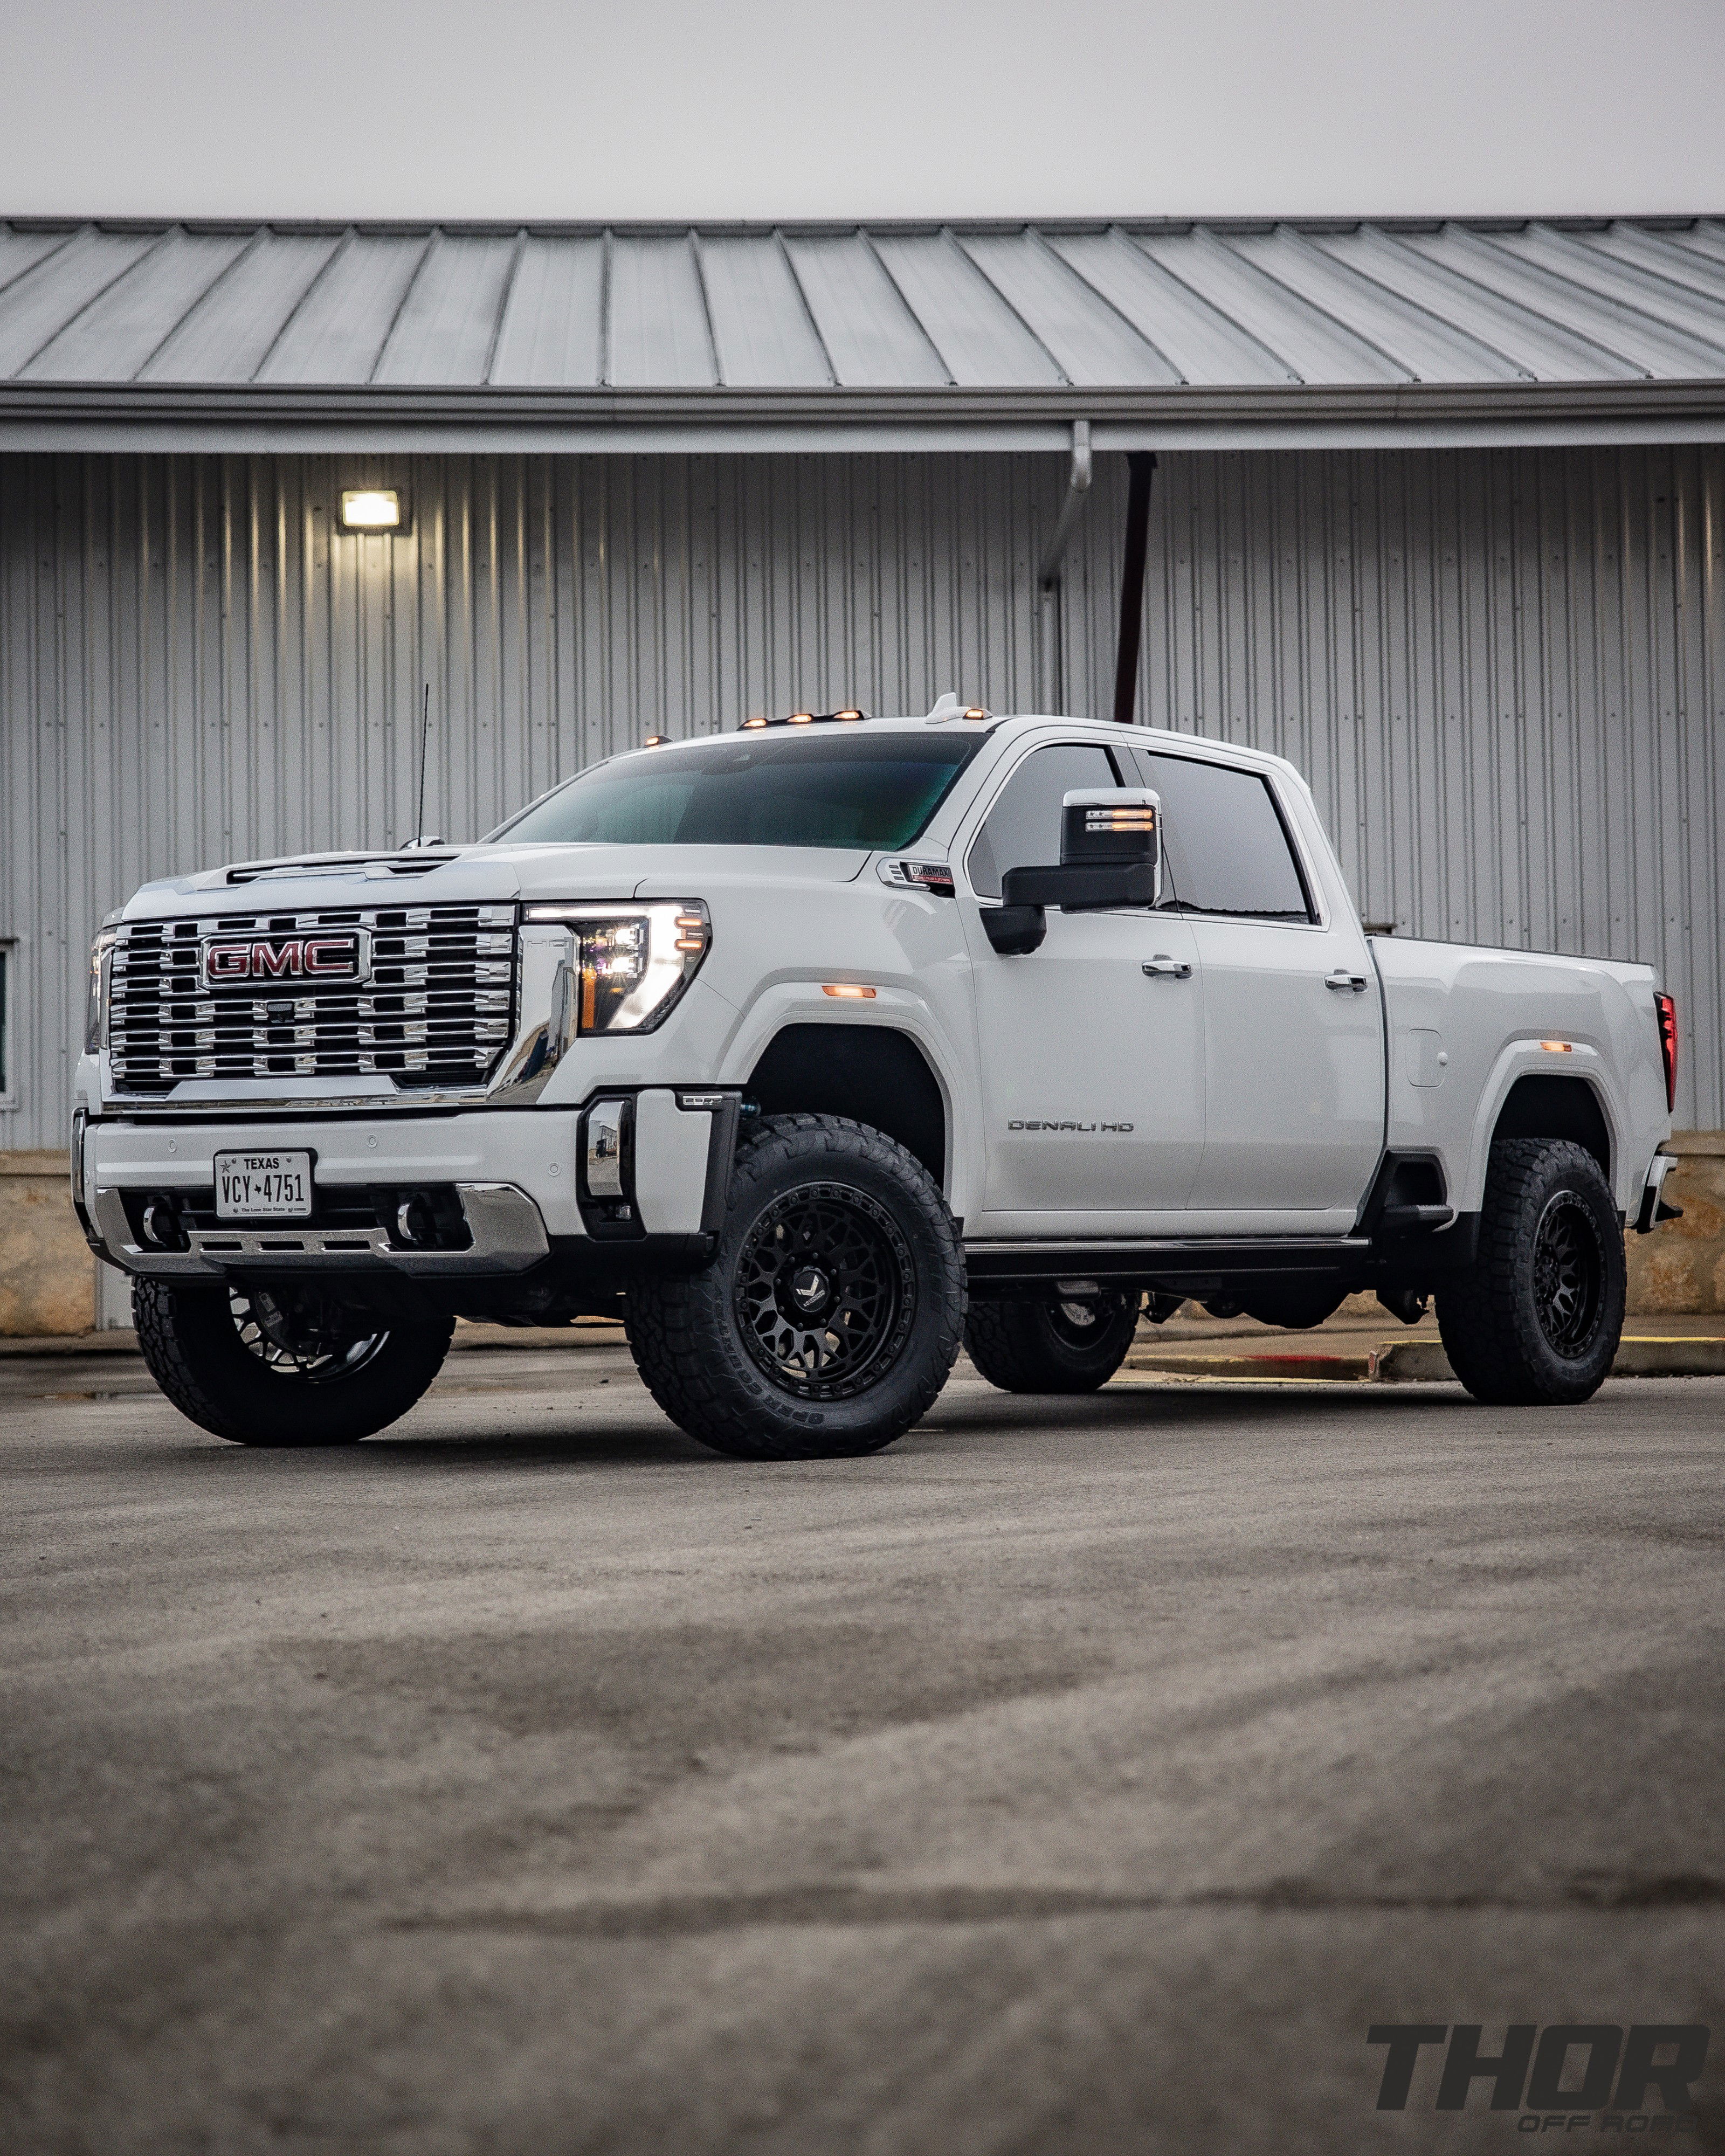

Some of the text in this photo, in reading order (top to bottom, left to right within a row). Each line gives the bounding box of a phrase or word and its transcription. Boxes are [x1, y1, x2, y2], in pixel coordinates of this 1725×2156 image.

[912, 866, 949, 877] DURAMAX
[527, 939, 569, 948] HD
[208, 938, 354, 979] GMC
[1008, 1119, 1134, 1132] DENALI HD
[244, 1158, 279, 1170] TEXAS
[764, 1395, 825, 1425] OPEN
